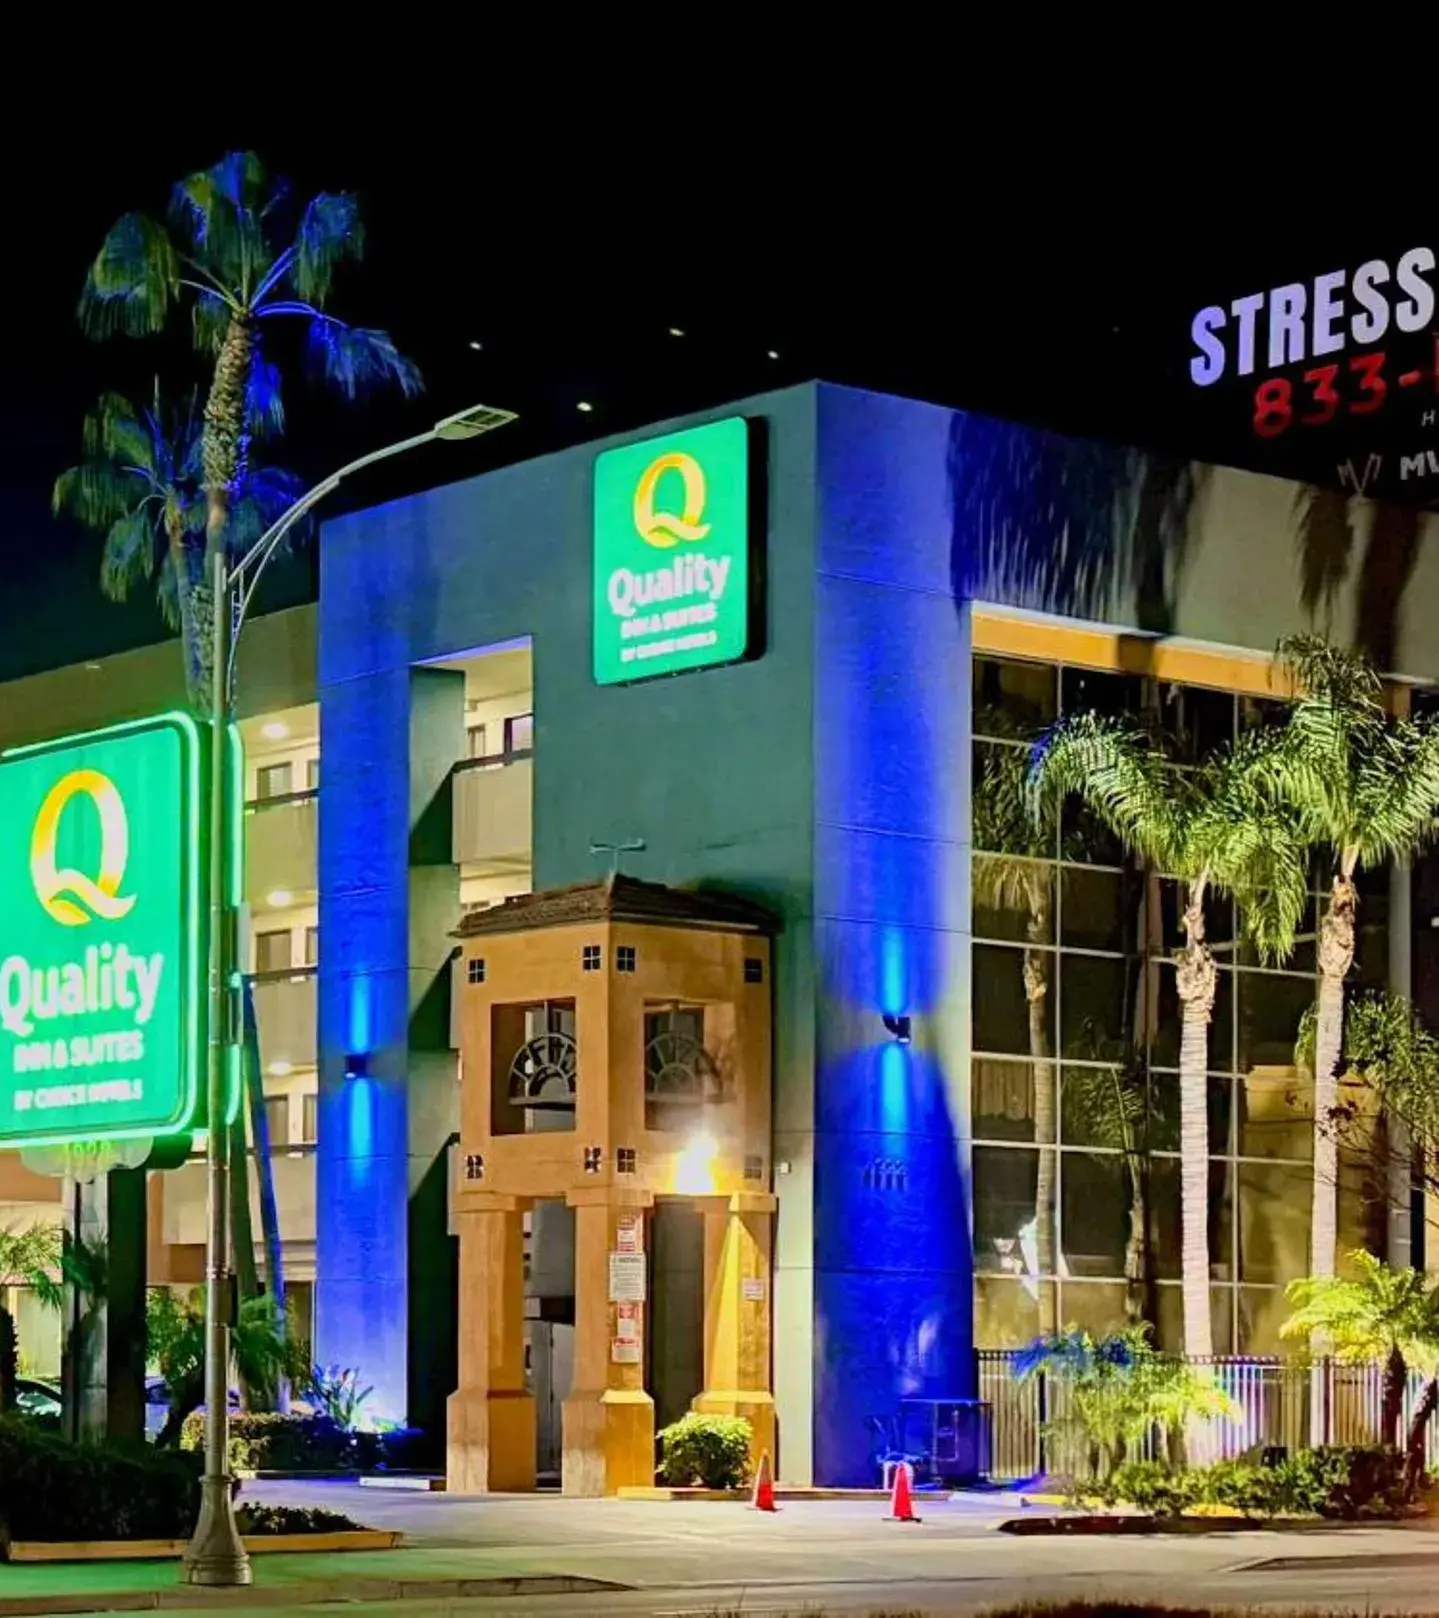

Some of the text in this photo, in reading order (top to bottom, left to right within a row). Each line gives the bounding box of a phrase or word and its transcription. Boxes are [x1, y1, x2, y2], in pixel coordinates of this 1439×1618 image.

[1190, 247, 1435, 386] STRESS
[633, 452, 711, 549] Q
[607, 553, 731, 617] Quality
[30, 769, 137, 926] Q
[70, 1029, 144, 1067] SUITES
